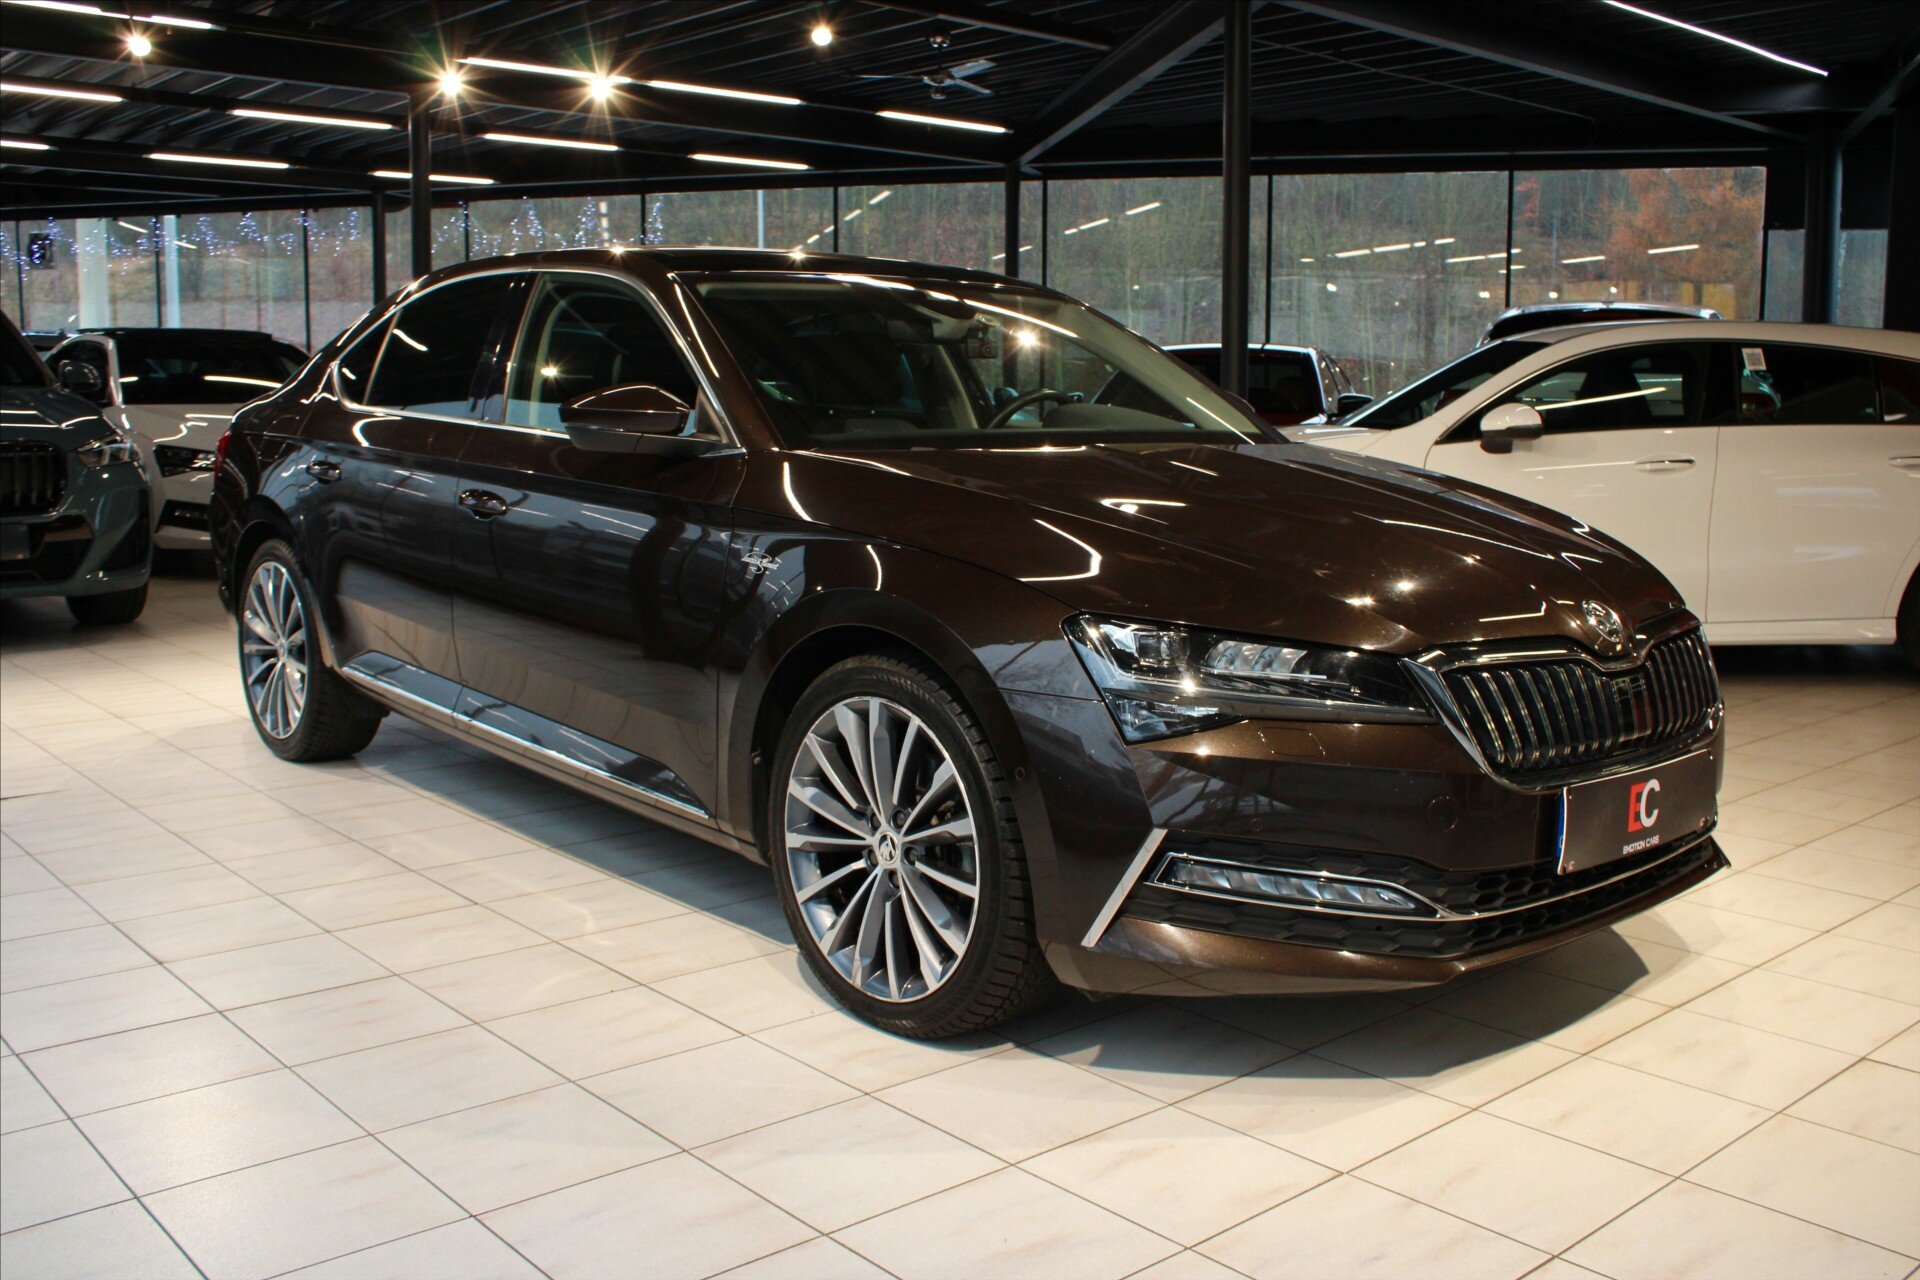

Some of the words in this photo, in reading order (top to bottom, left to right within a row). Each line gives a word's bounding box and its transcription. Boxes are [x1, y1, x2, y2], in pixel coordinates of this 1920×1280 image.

[1628, 779, 1660, 832] EC
[1623, 840, 1645, 854] EMOTION
[1645, 835, 1660, 847] CARS
